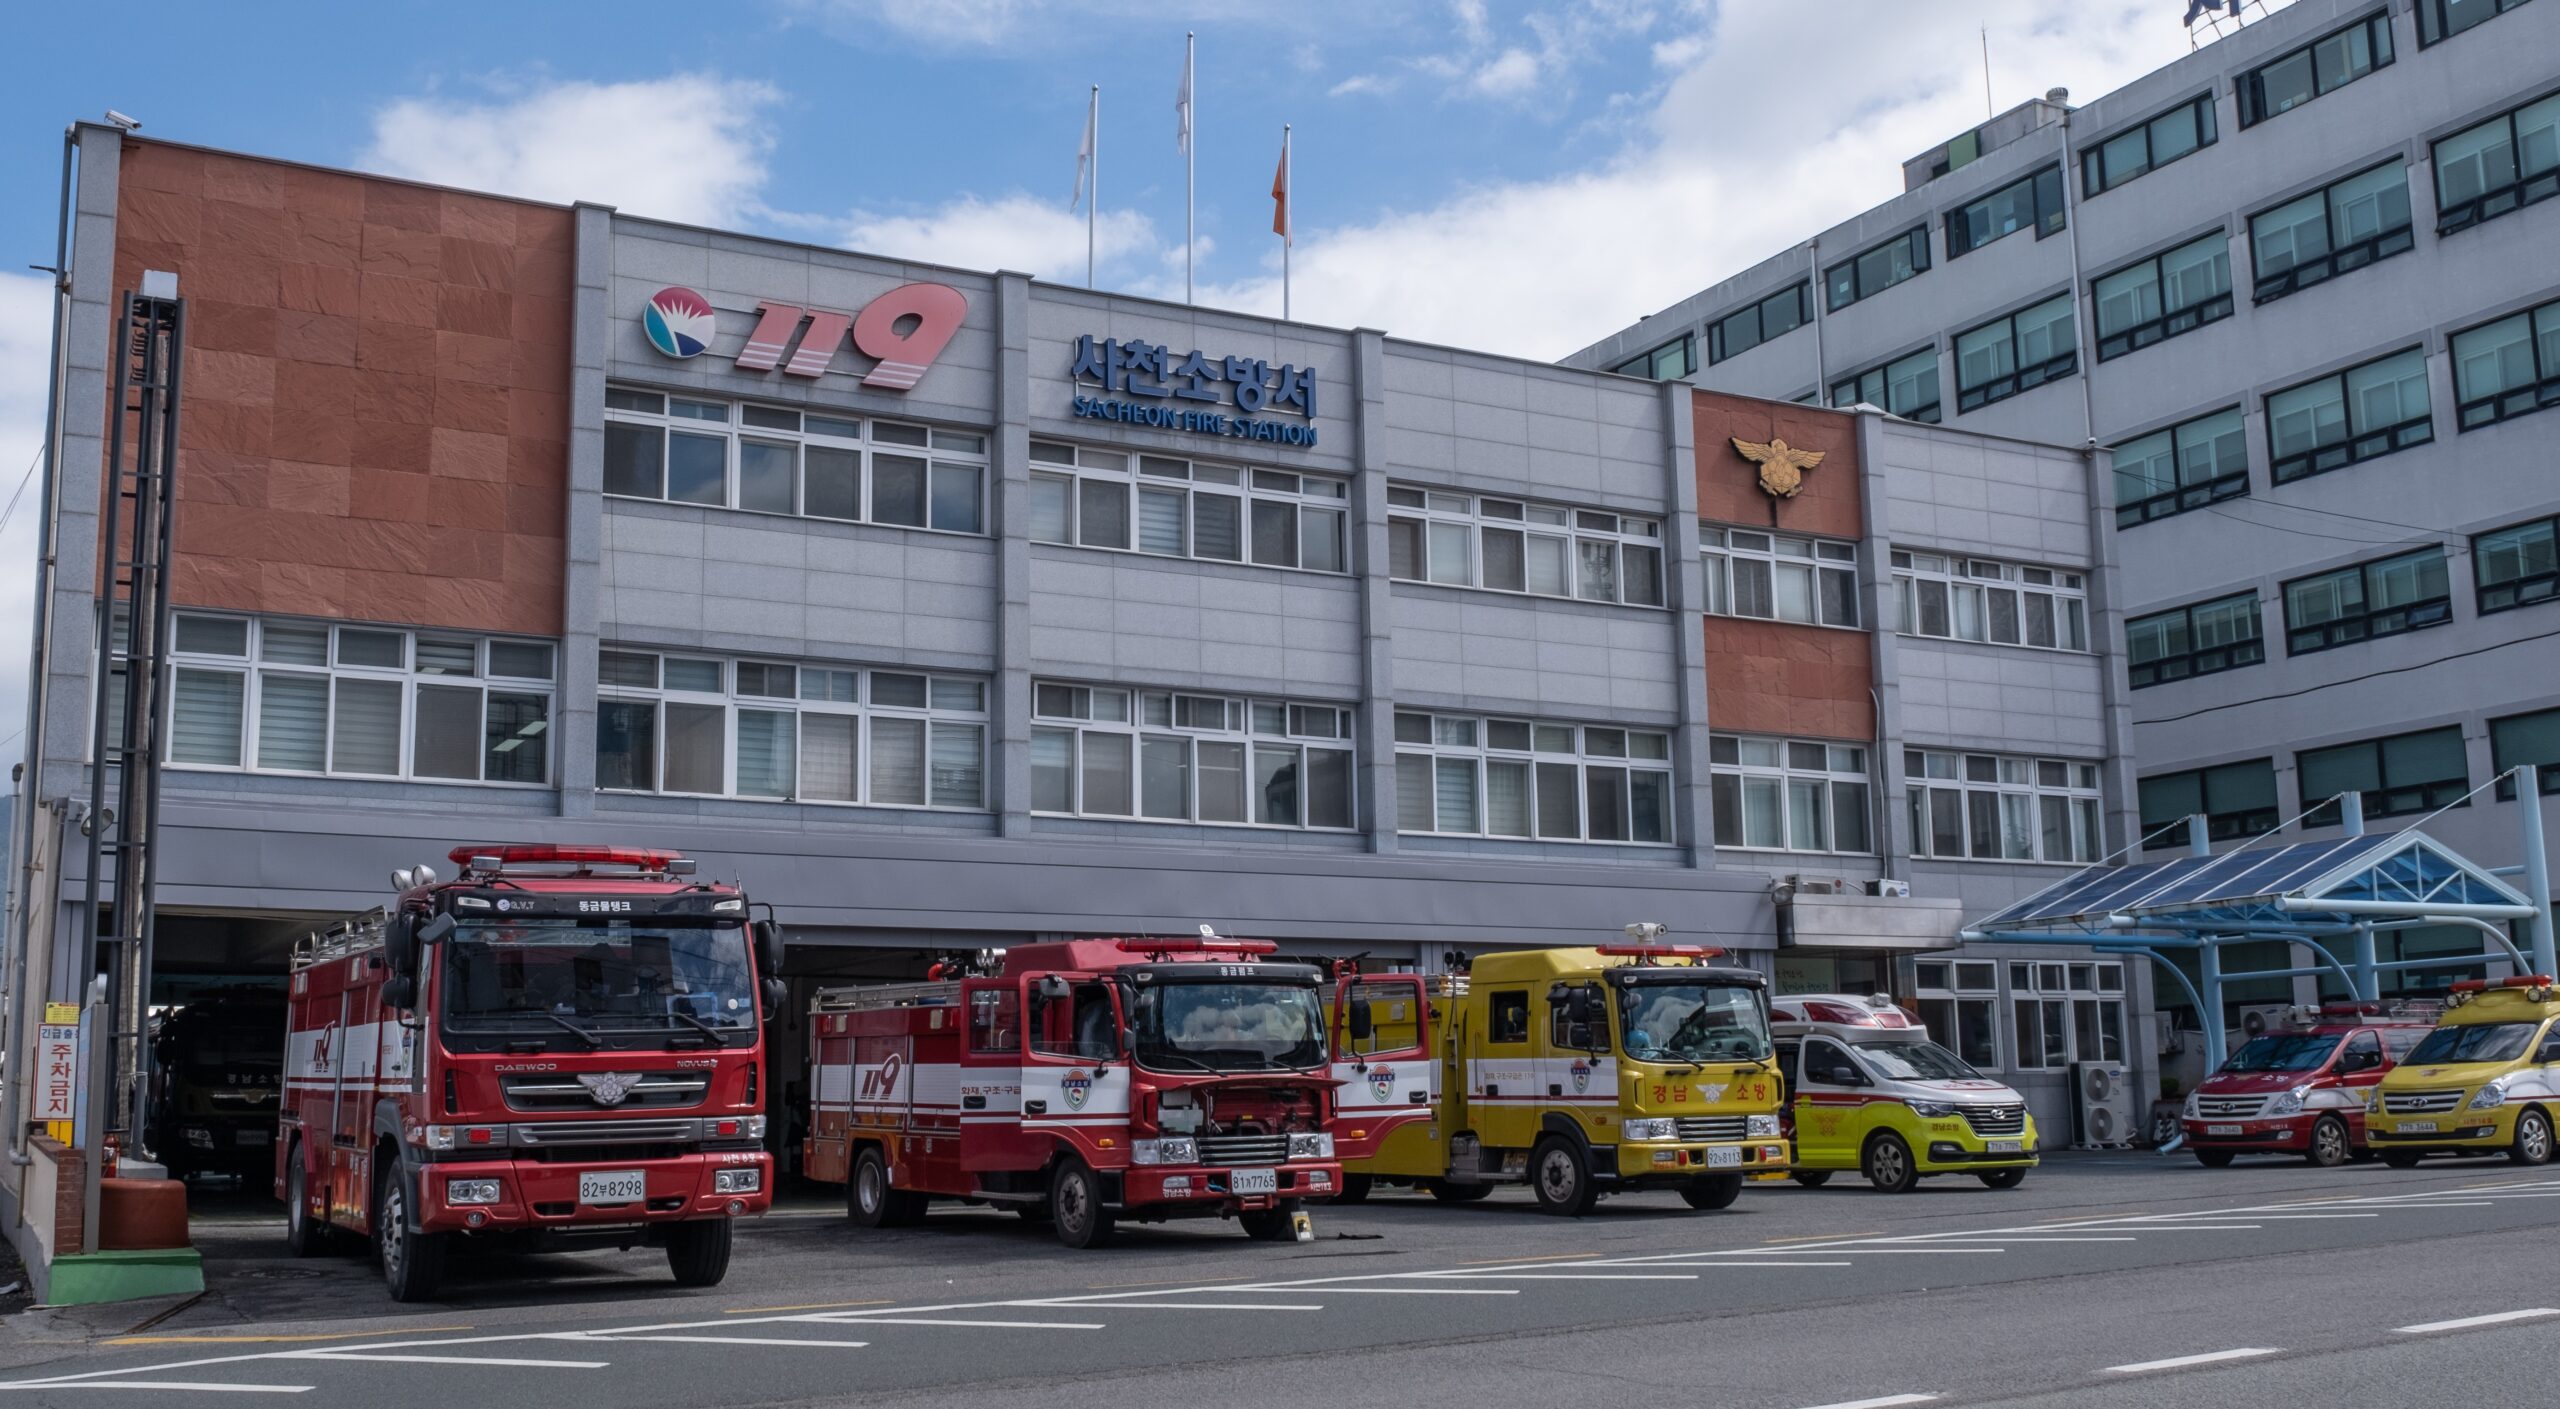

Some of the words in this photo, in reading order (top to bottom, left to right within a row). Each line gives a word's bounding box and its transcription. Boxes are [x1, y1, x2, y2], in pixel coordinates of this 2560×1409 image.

[735, 282, 967, 390] 119
[1073, 335, 1316, 418] 사천소방서
[1073, 396, 1176, 428] SACHEON
[1182, 409, 1226, 434] FIRE
[1231, 415, 1317, 447] STATION
[579, 901, 631, 911] 동금물탱크
[48, 1044, 72, 1114] 주차금지
[494, 1063, 557, 1071] DAEWOO
[860, 1053, 901, 1100] 119
[1653, 1085, 1688, 1103] 경남
[1737, 1083, 1766, 1101] 소방
[582, 1180, 642, 1198] 82부8298
